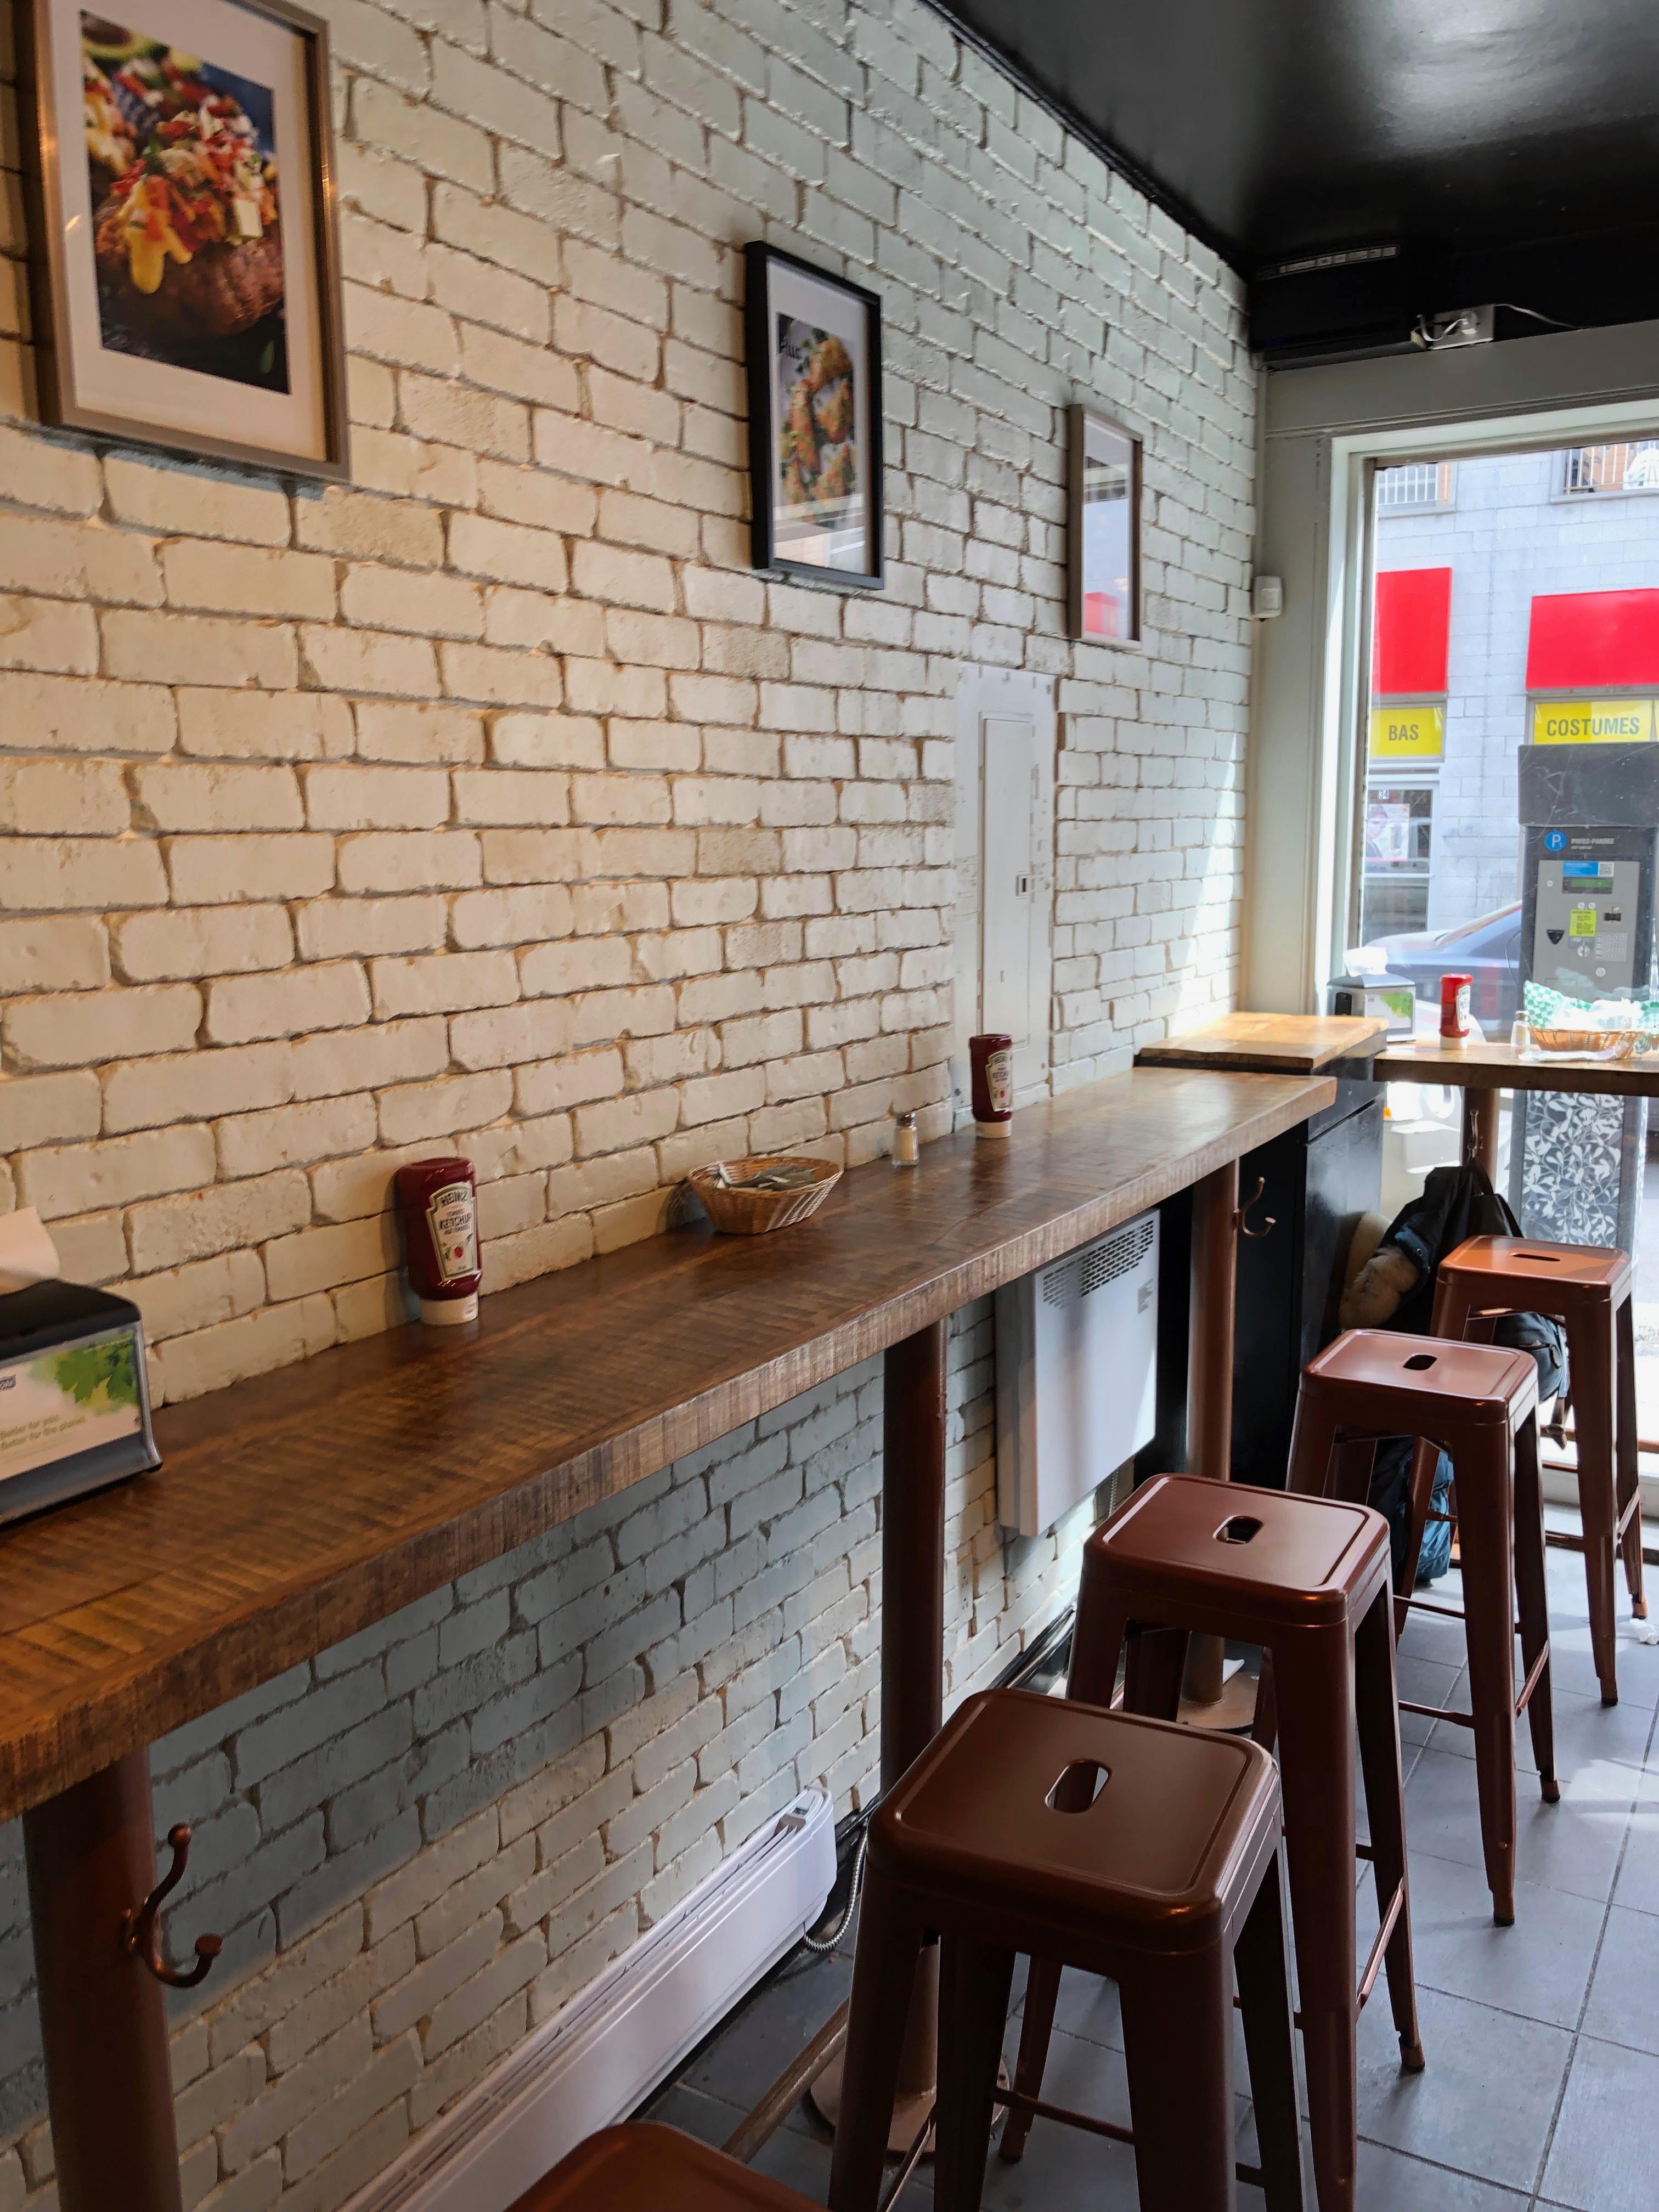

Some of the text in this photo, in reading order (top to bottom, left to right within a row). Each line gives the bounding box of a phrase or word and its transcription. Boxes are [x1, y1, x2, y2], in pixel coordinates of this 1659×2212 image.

[1389, 724, 1419, 741] BAS
[1547, 717, 1639, 736] COSTUMES
[440, 1190, 468, 1207] HEINZ
[440, 1212, 472, 1229] KETCHUP
